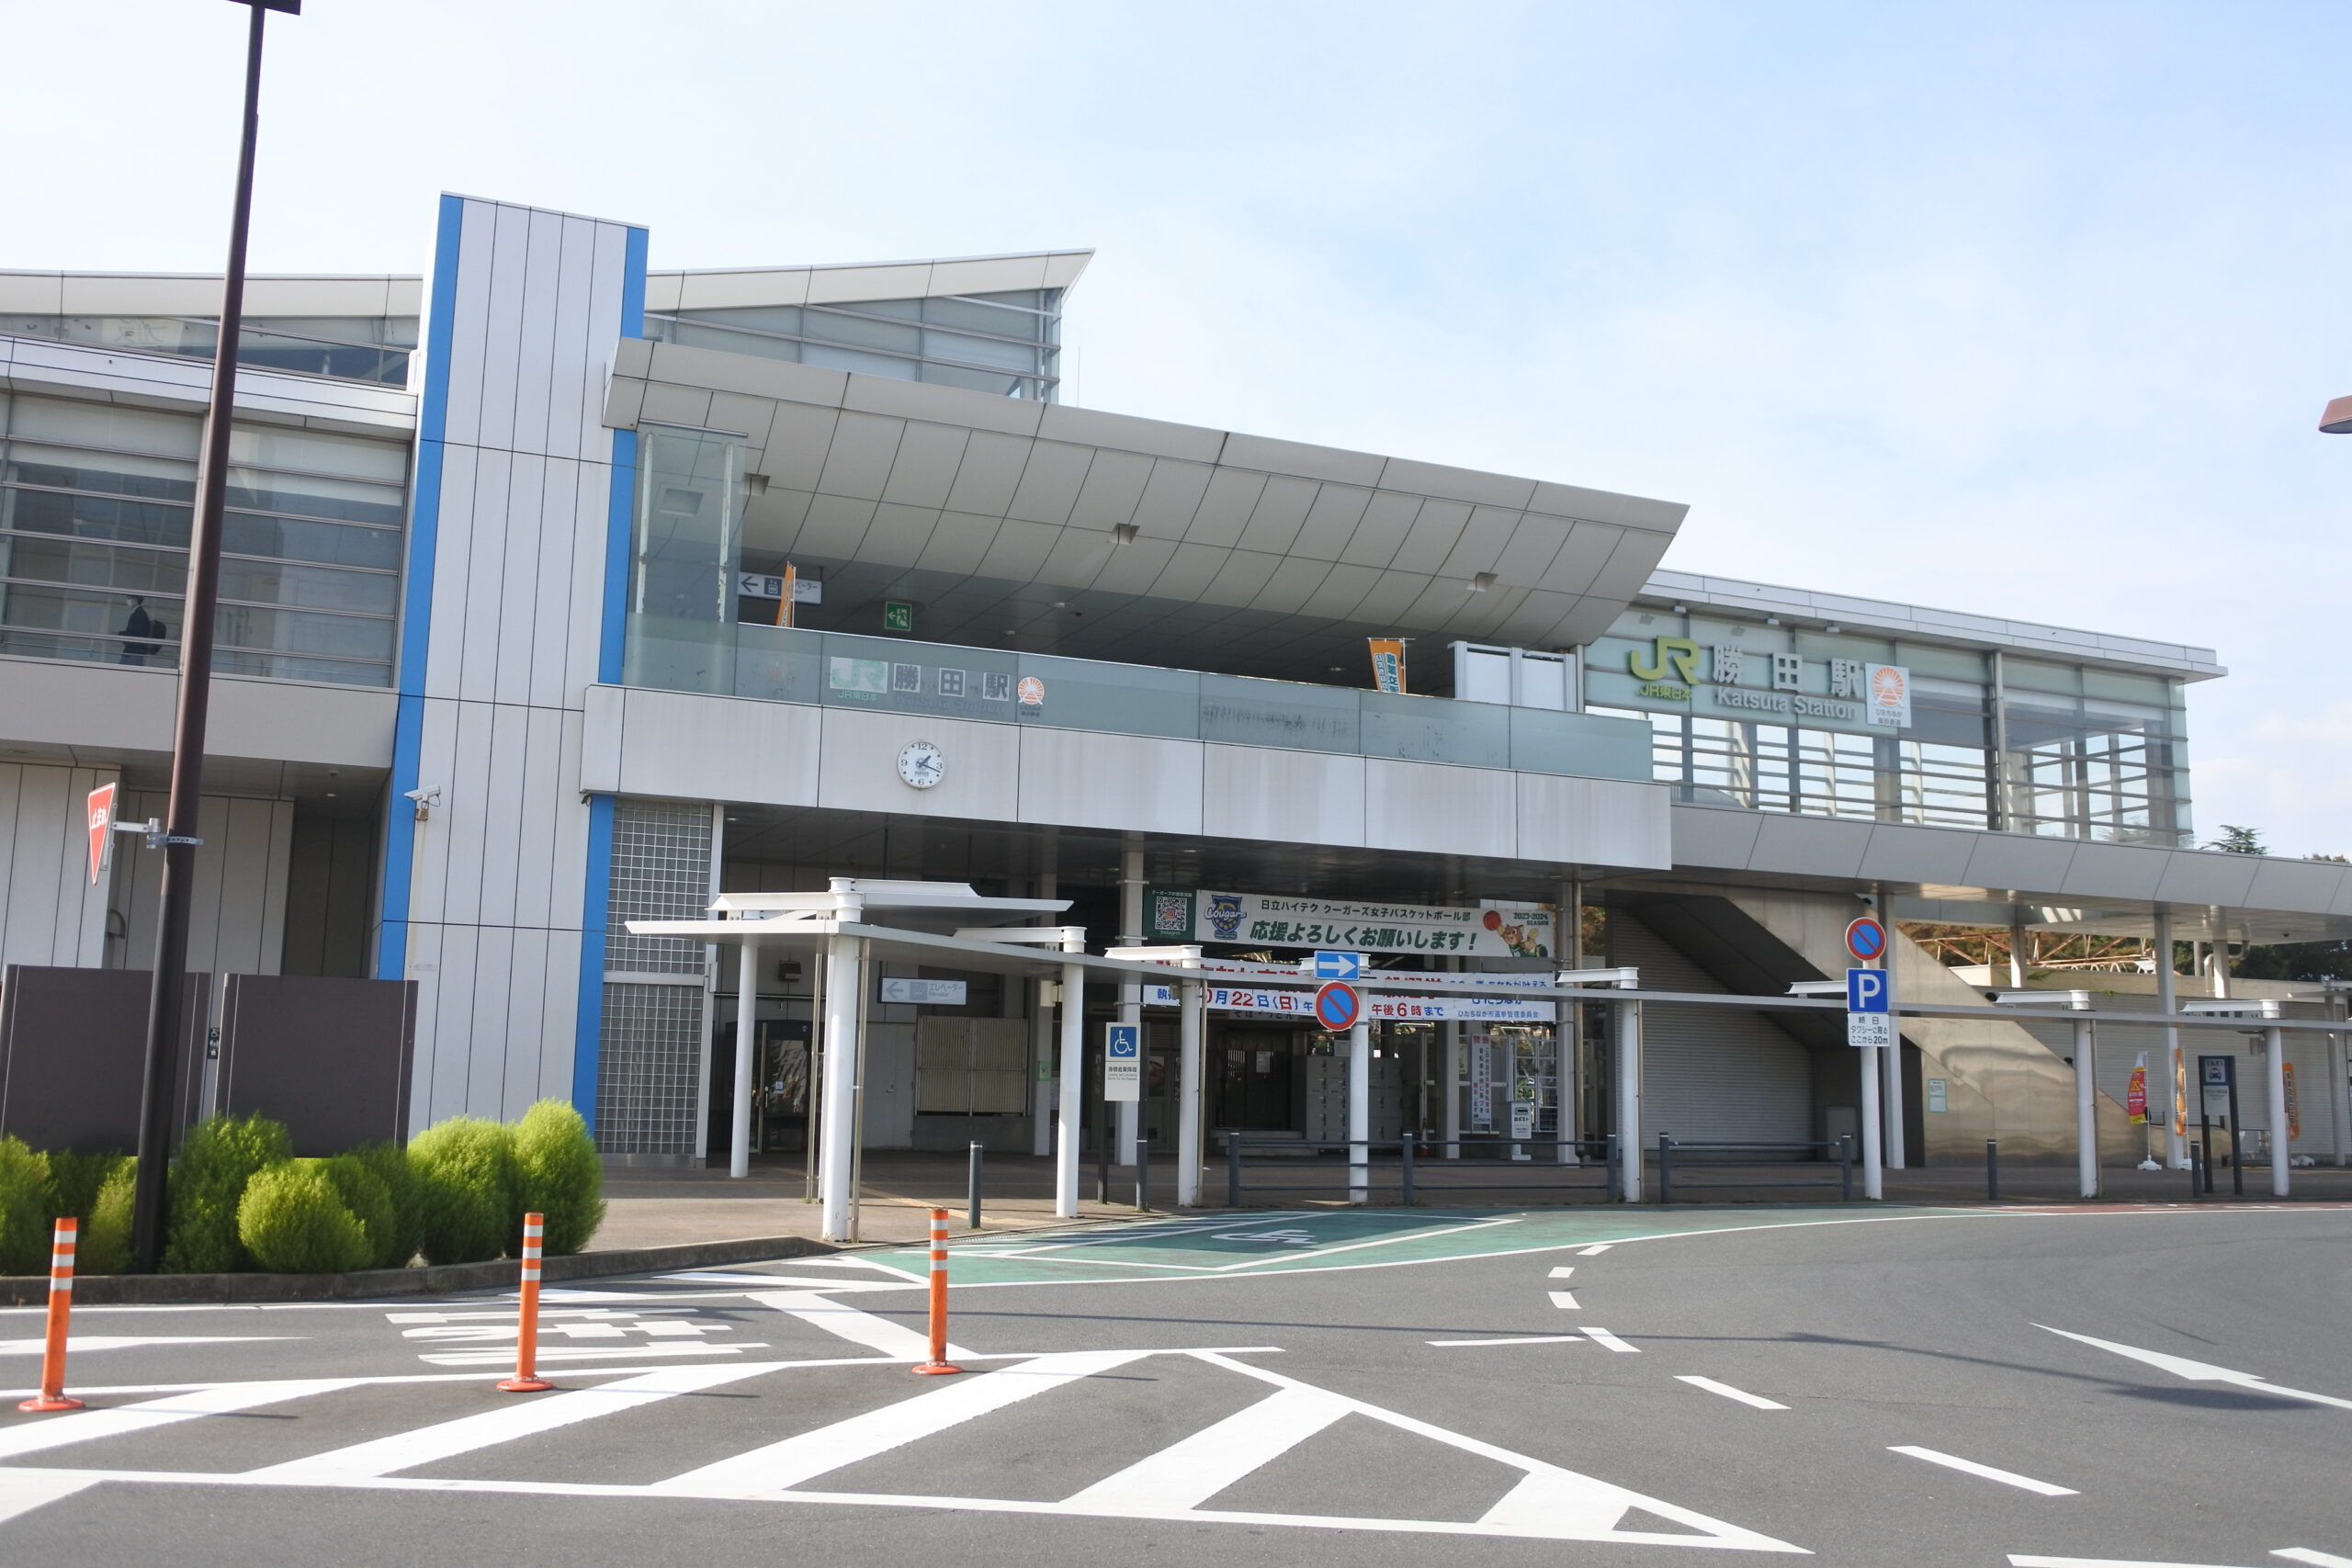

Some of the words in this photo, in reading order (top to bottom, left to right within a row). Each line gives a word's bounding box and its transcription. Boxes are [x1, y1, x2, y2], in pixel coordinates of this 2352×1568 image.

[1630, 636, 1700, 684] JR
[1713, 644, 1860, 697] 勝田駅
[895, 664, 1009, 700] 勝田駅
[1639, 683, 1691, 699] JR東日本
[1717, 686, 1789, 712] Katsuta
[1793, 695, 1856, 719] Station
[1204, 904, 1247, 921] Cougars
[1261, 899, 1318, 912] 日立ハイテク
[1324, 904, 1471, 921] クーガーズ女子バスケットボール部
[1858, 974, 1881, 1009] P
[1372, 1002, 1444, 1017] 午後6時まで
